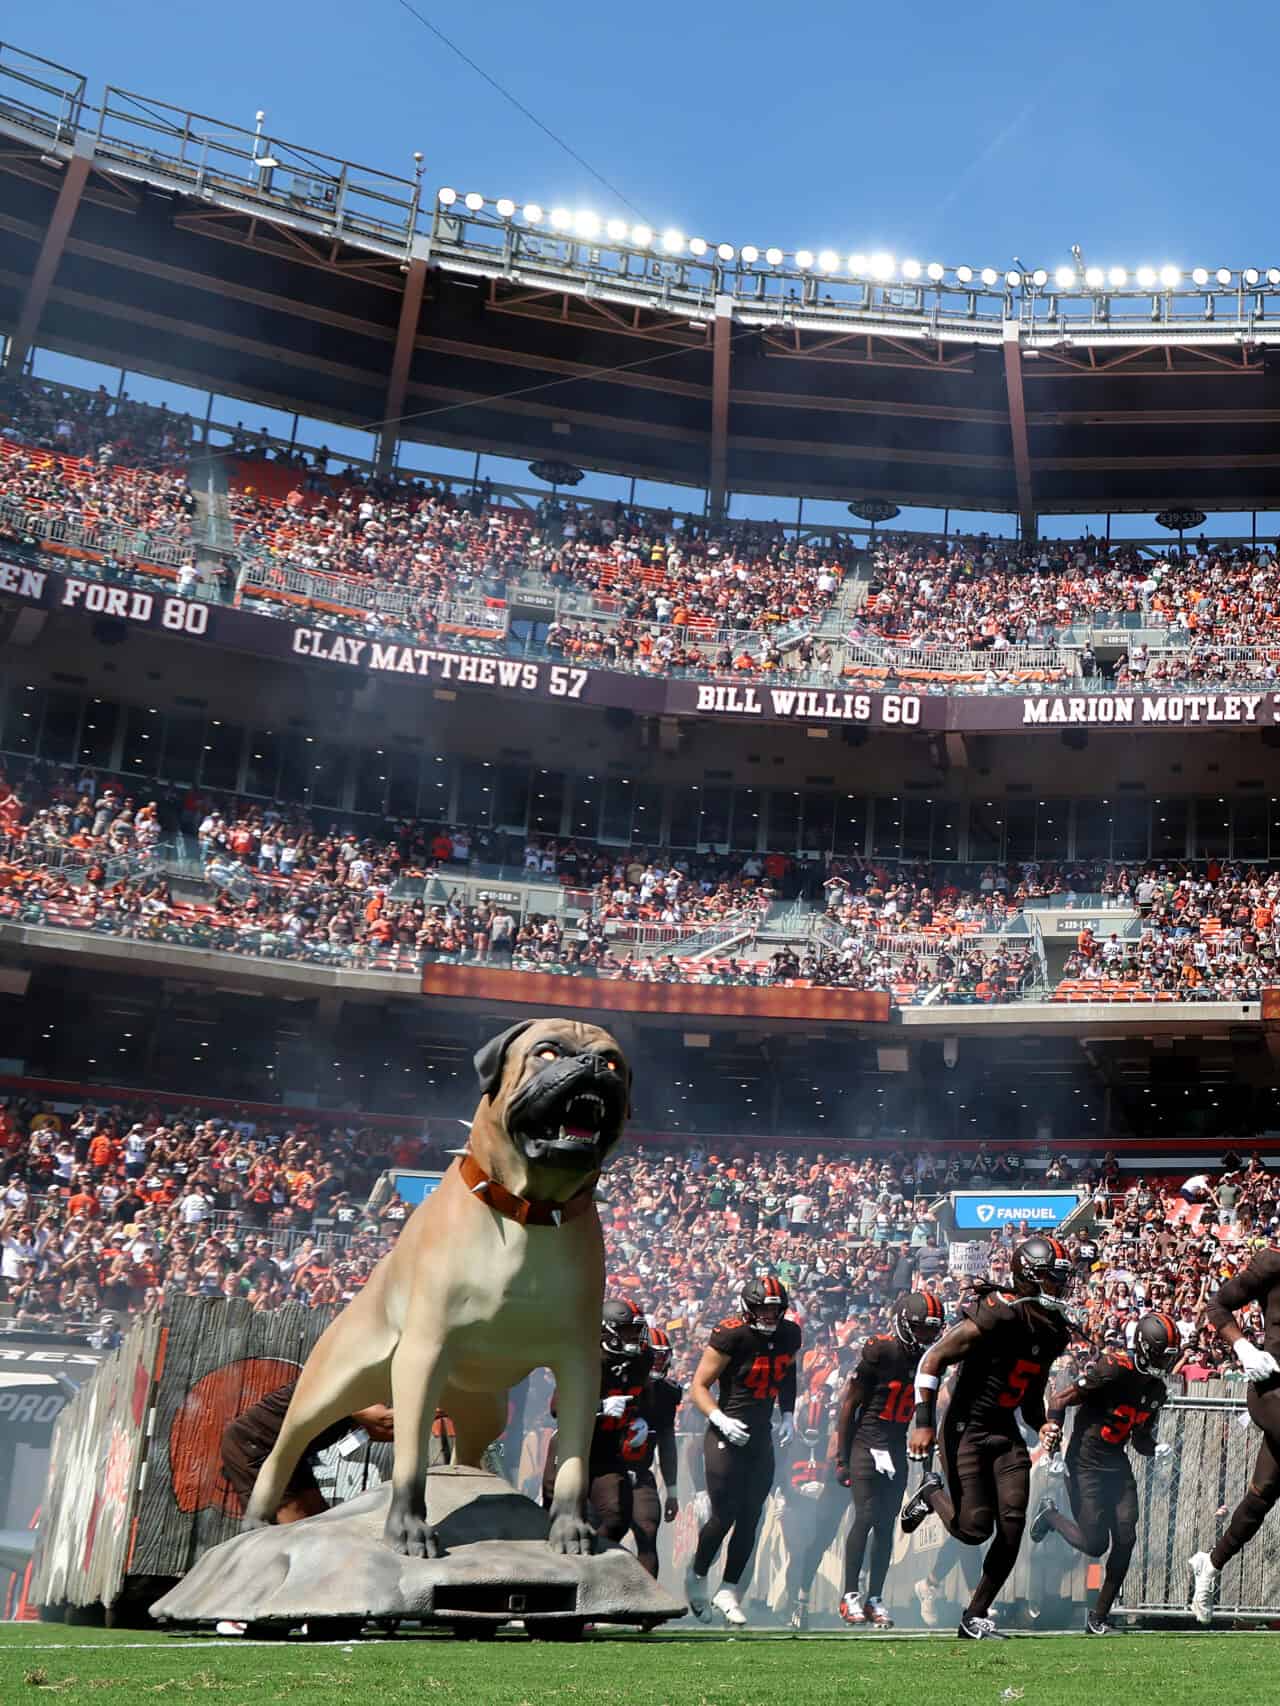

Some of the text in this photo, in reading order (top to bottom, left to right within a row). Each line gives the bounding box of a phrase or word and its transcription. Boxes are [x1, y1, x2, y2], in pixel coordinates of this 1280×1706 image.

[62, 578, 153, 622] FORD
[162, 597, 209, 635] 80
[292, 627, 588, 698] CLAY MATTHEWS 57
[696, 685, 921, 725] BILL WILLIS 60
[1022, 698, 1134, 723] MARION
[1142, 696, 1262, 722] MOTLEY
[997, 1207, 1056, 1219] FANDUEL
[997, 1359, 1041, 1408] 5
